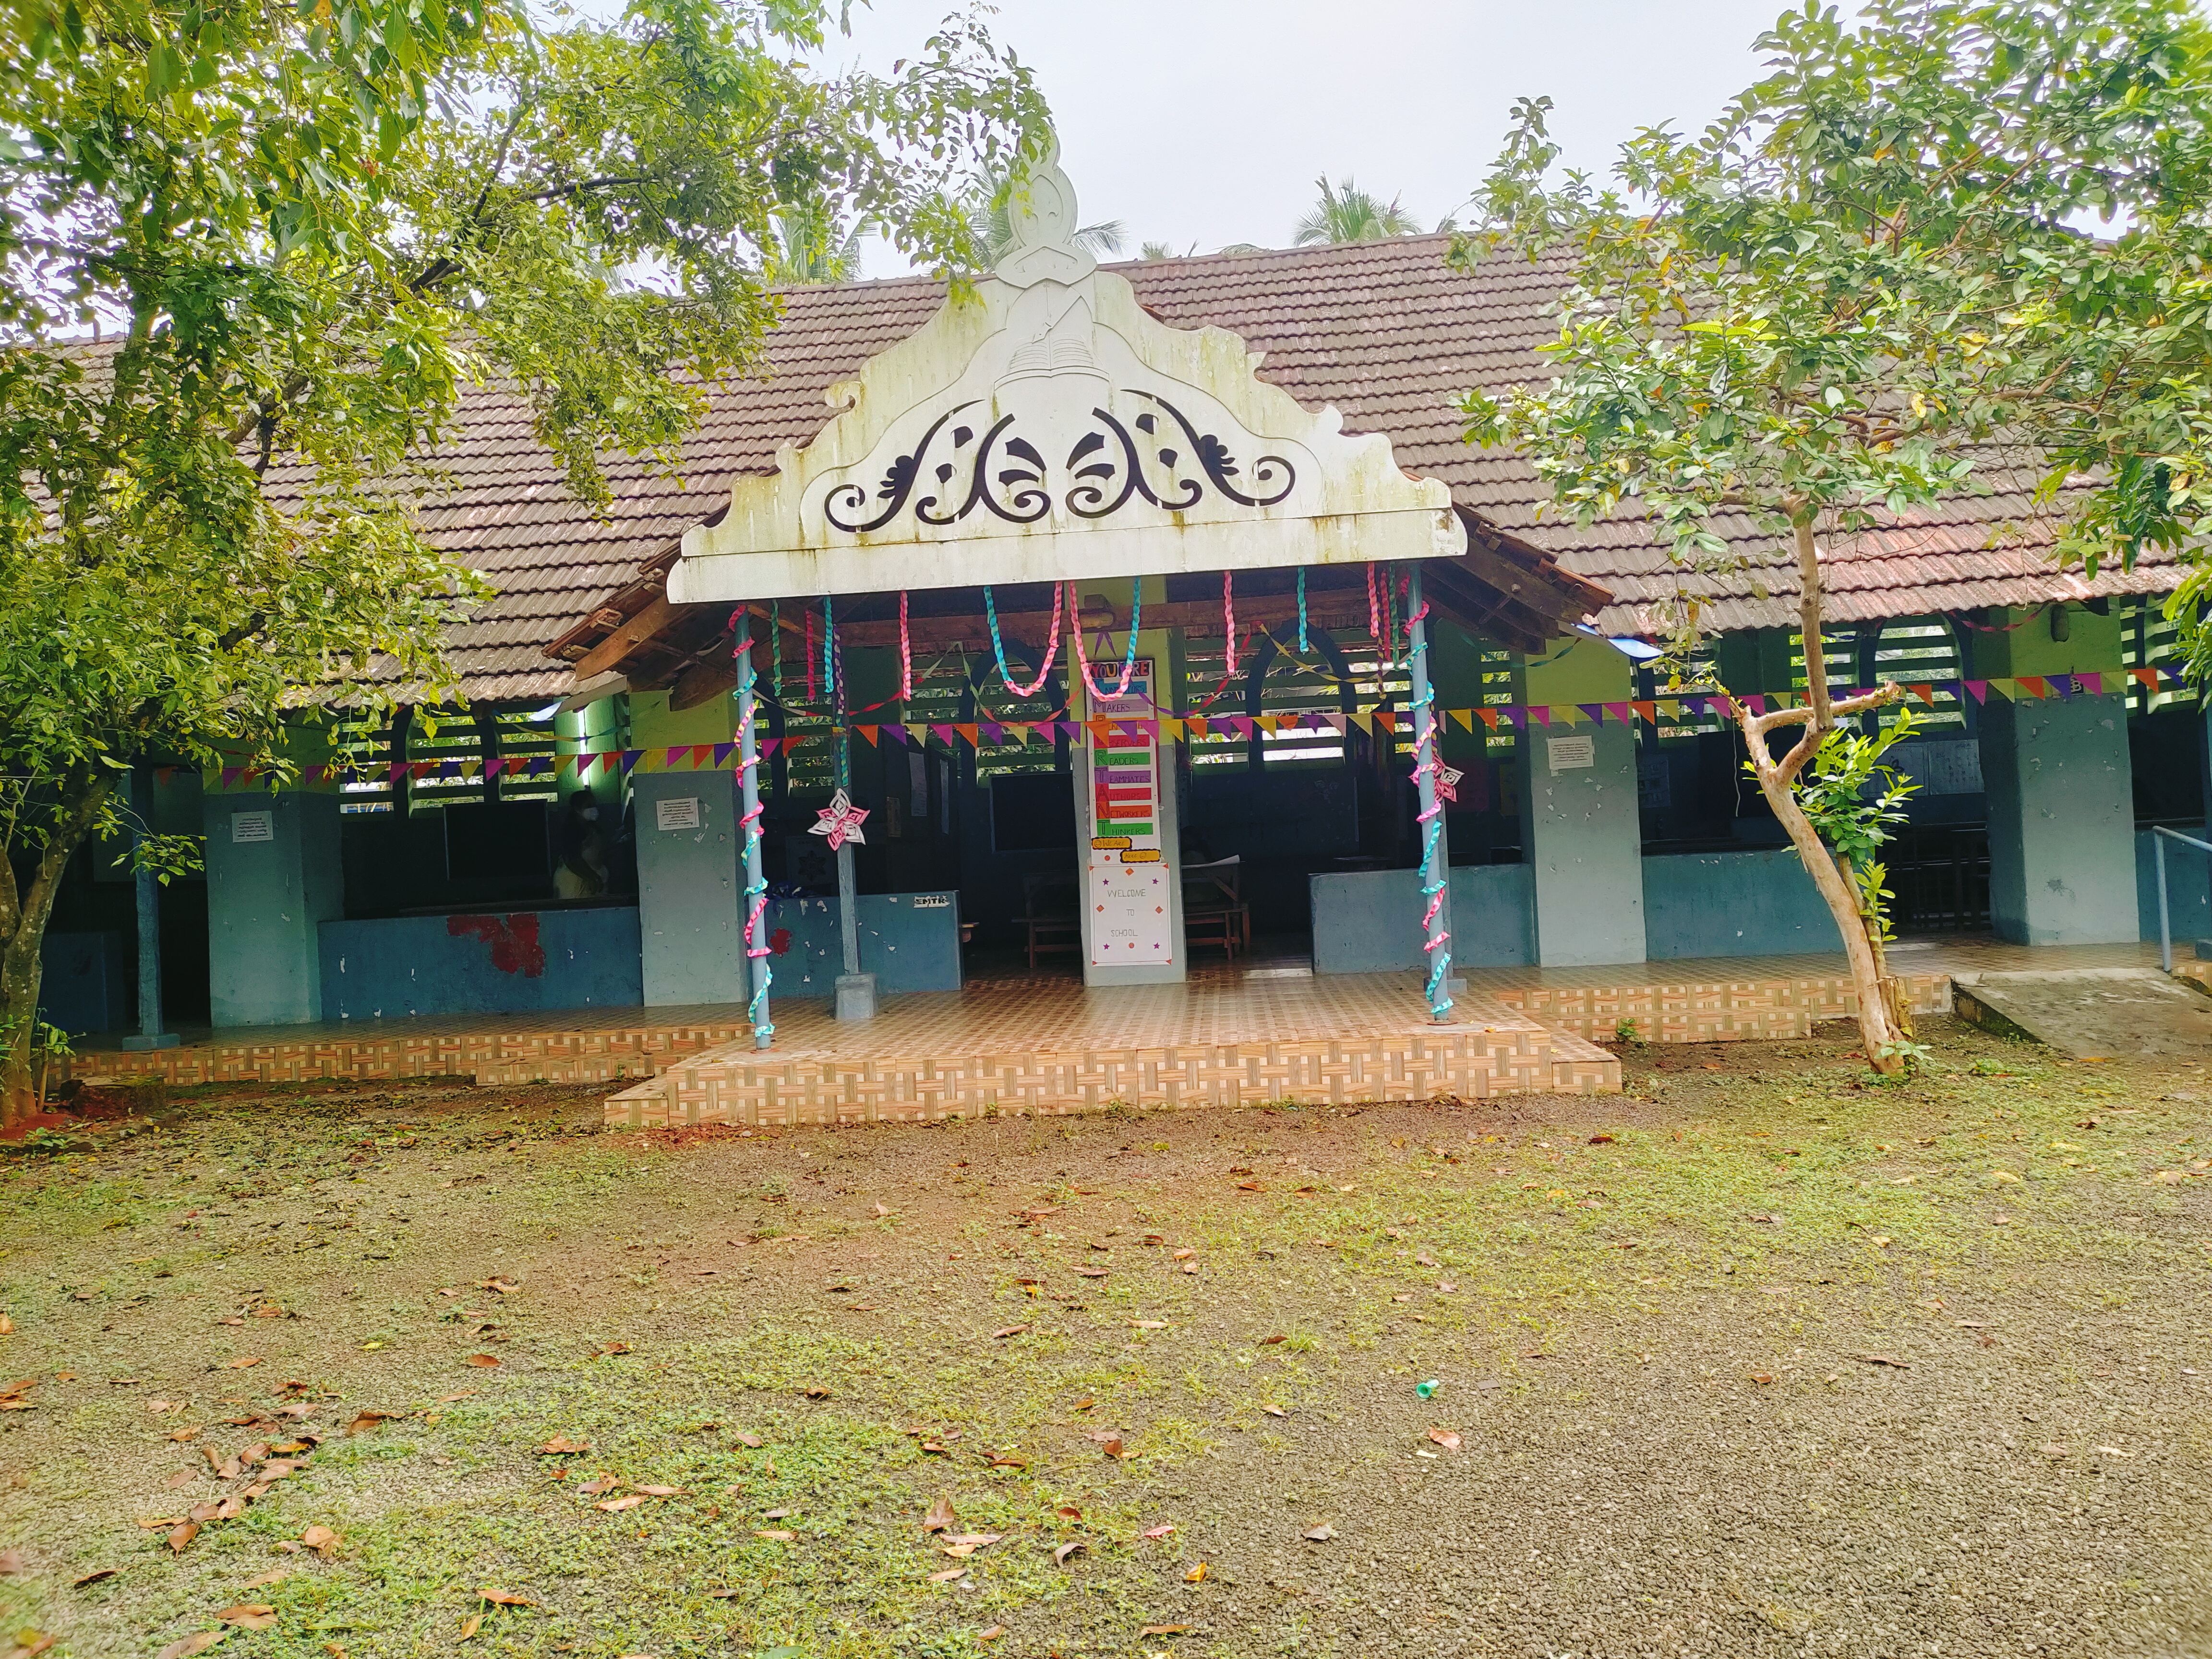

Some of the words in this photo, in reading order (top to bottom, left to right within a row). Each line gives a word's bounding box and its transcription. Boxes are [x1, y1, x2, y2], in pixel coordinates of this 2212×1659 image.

[1093, 698, 1130, 713] MAKERS
[1095, 749, 1139, 766] READERS
[1094, 767, 1150, 783] TEAMMATES
[1096, 784, 1141, 802] AUTHORS
[1096, 802, 1150, 818] NETWORKERS
[1097, 820, 1145, 835] THINKERS
[1107, 889, 1146, 898] WELCOME
[1111, 929, 1139, 937] SCHOOL
